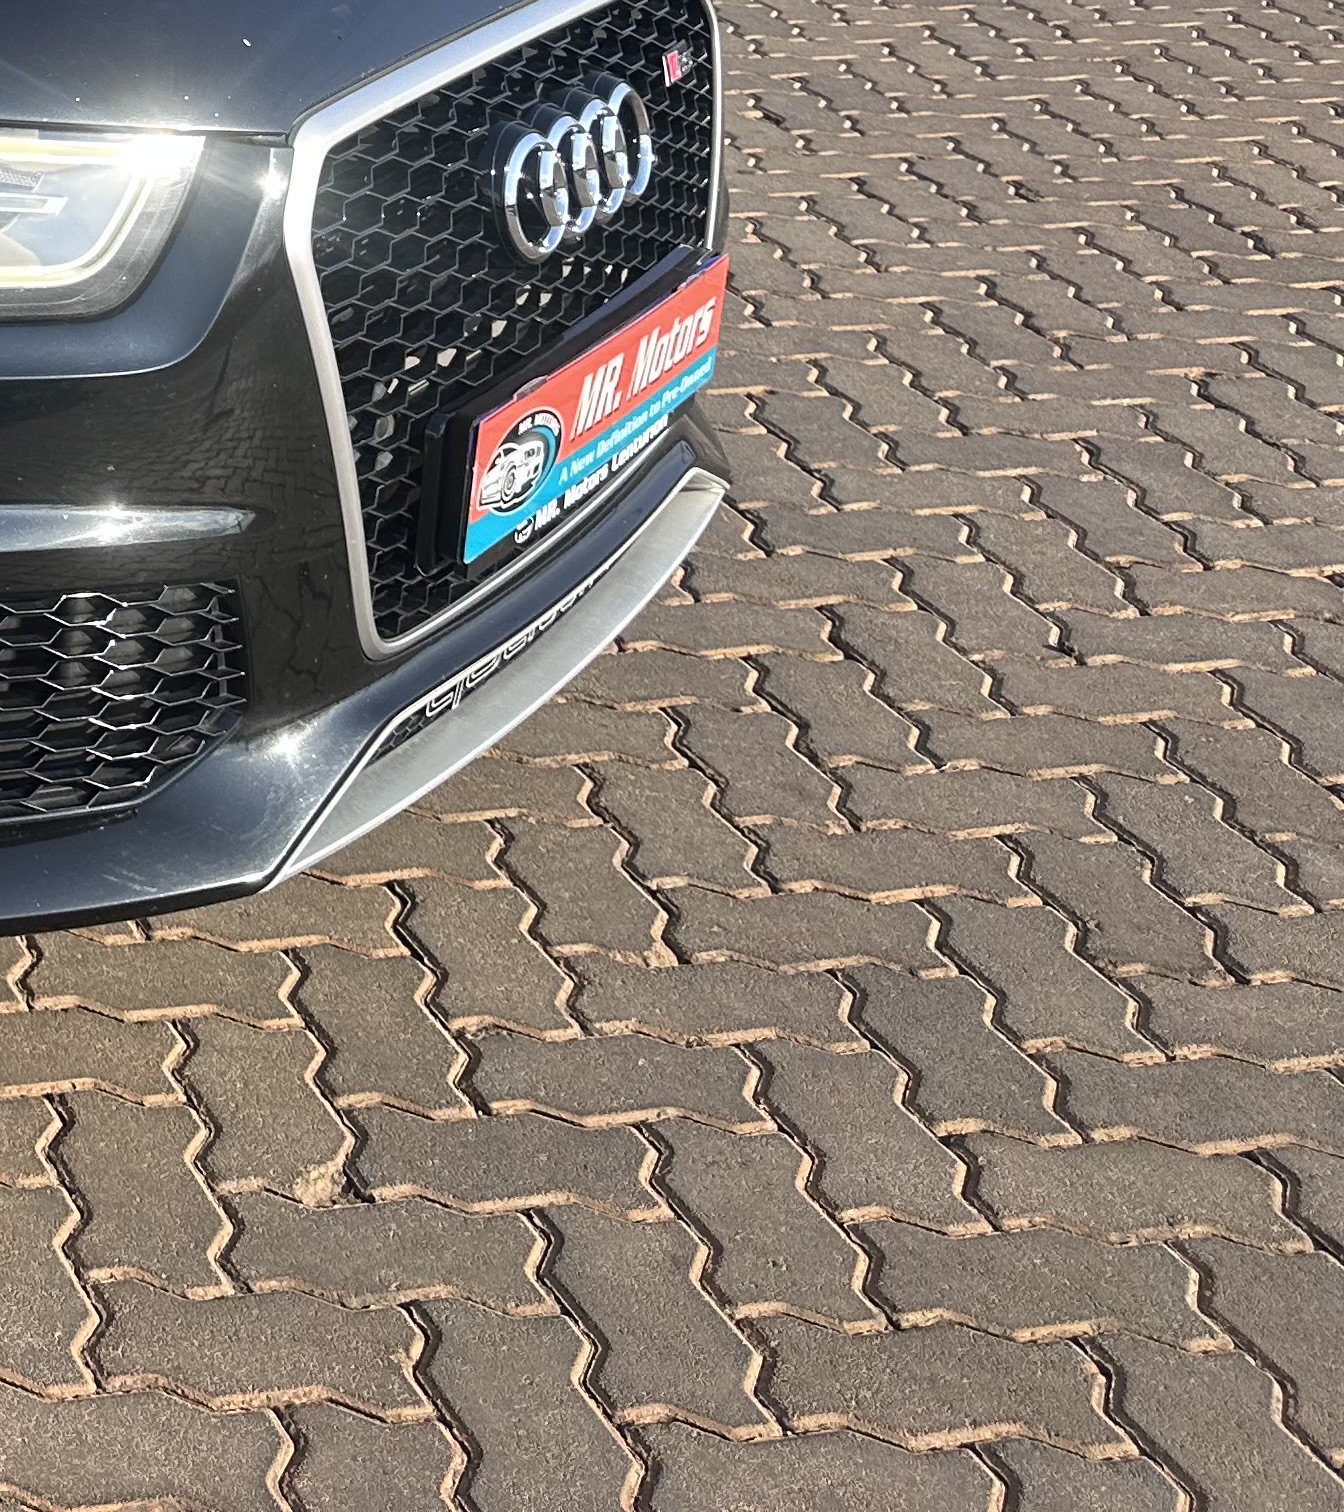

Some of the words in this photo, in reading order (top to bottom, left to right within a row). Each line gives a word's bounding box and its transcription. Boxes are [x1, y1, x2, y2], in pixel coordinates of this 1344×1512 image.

[569, 352, 625, 442] MR.
[625, 296, 717, 401] Motors
[557, 466, 569, 486] A
[570, 450, 596, 478] New
[563, 463, 610, 510] Motors
